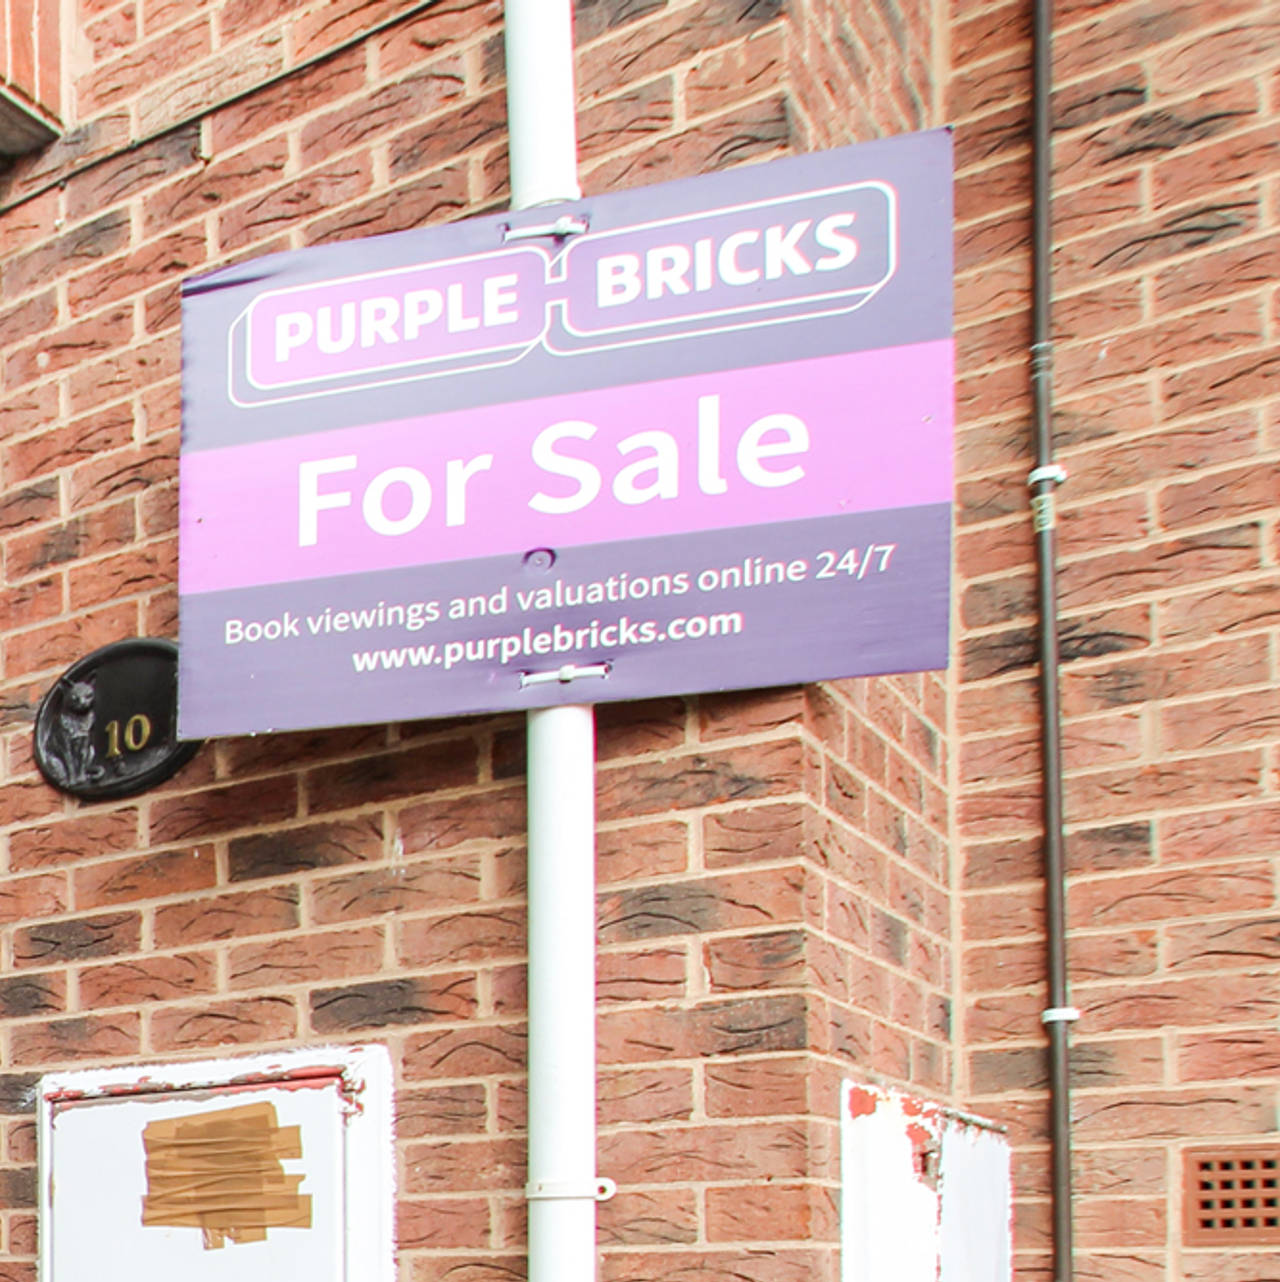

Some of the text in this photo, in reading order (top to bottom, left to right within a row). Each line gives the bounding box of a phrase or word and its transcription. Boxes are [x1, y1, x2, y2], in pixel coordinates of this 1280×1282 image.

[274, 213, 858, 363] PURPLE BRICKS
[298, 394, 810, 547] For Sale
[224, 543, 898, 645] Book viewings and valuations online 24/7
[352, 611, 744, 672] www.purplebricks.com
[105, 713, 152, 758] 10
